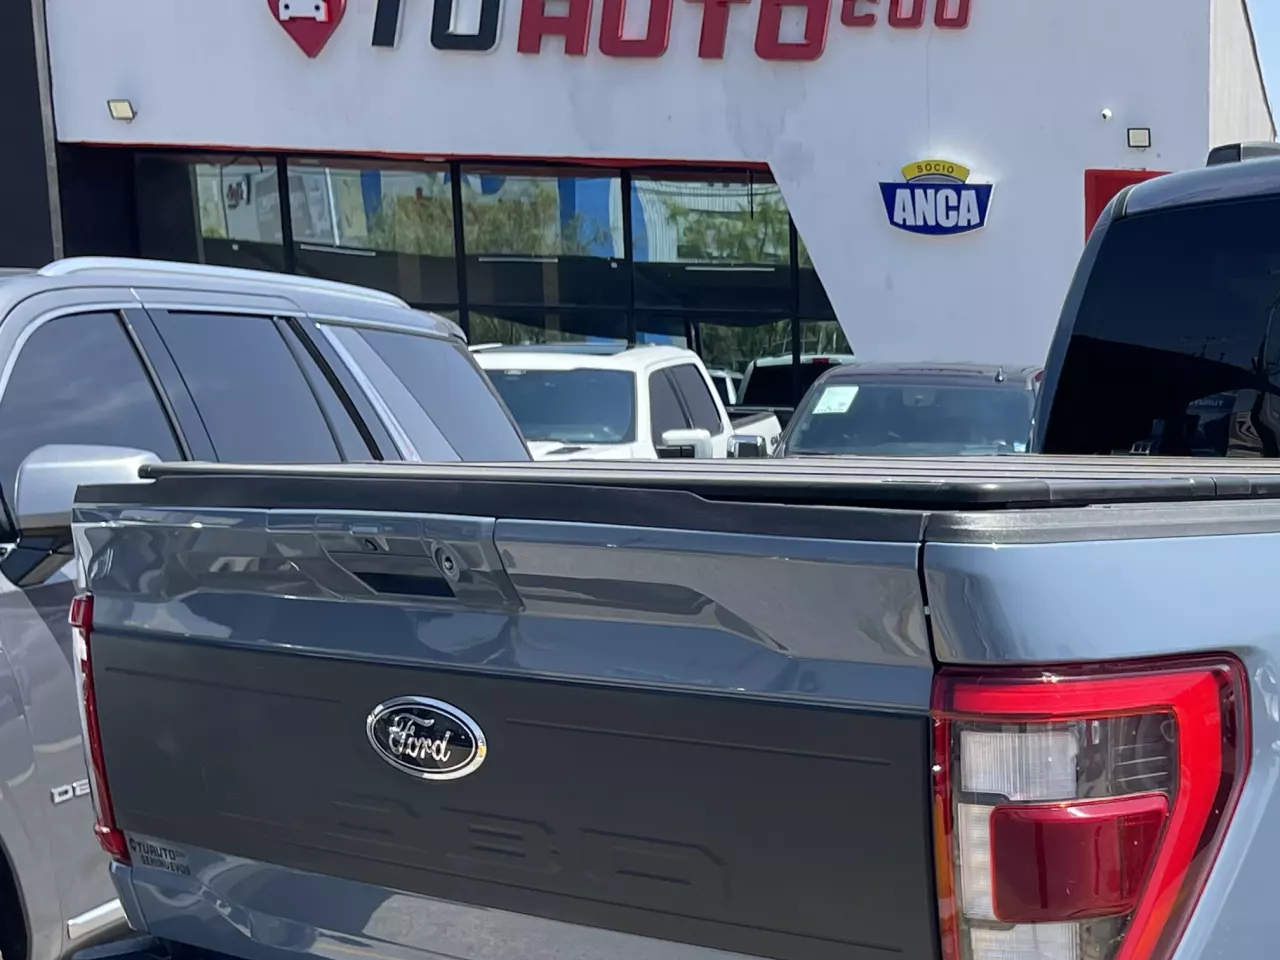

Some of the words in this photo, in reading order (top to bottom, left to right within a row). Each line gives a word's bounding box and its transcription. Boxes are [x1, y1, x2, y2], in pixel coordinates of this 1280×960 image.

[916, 163, 955, 174] SOCIO
[893, 188, 980, 227] ANCA
[389, 713, 451, 762] Ford
